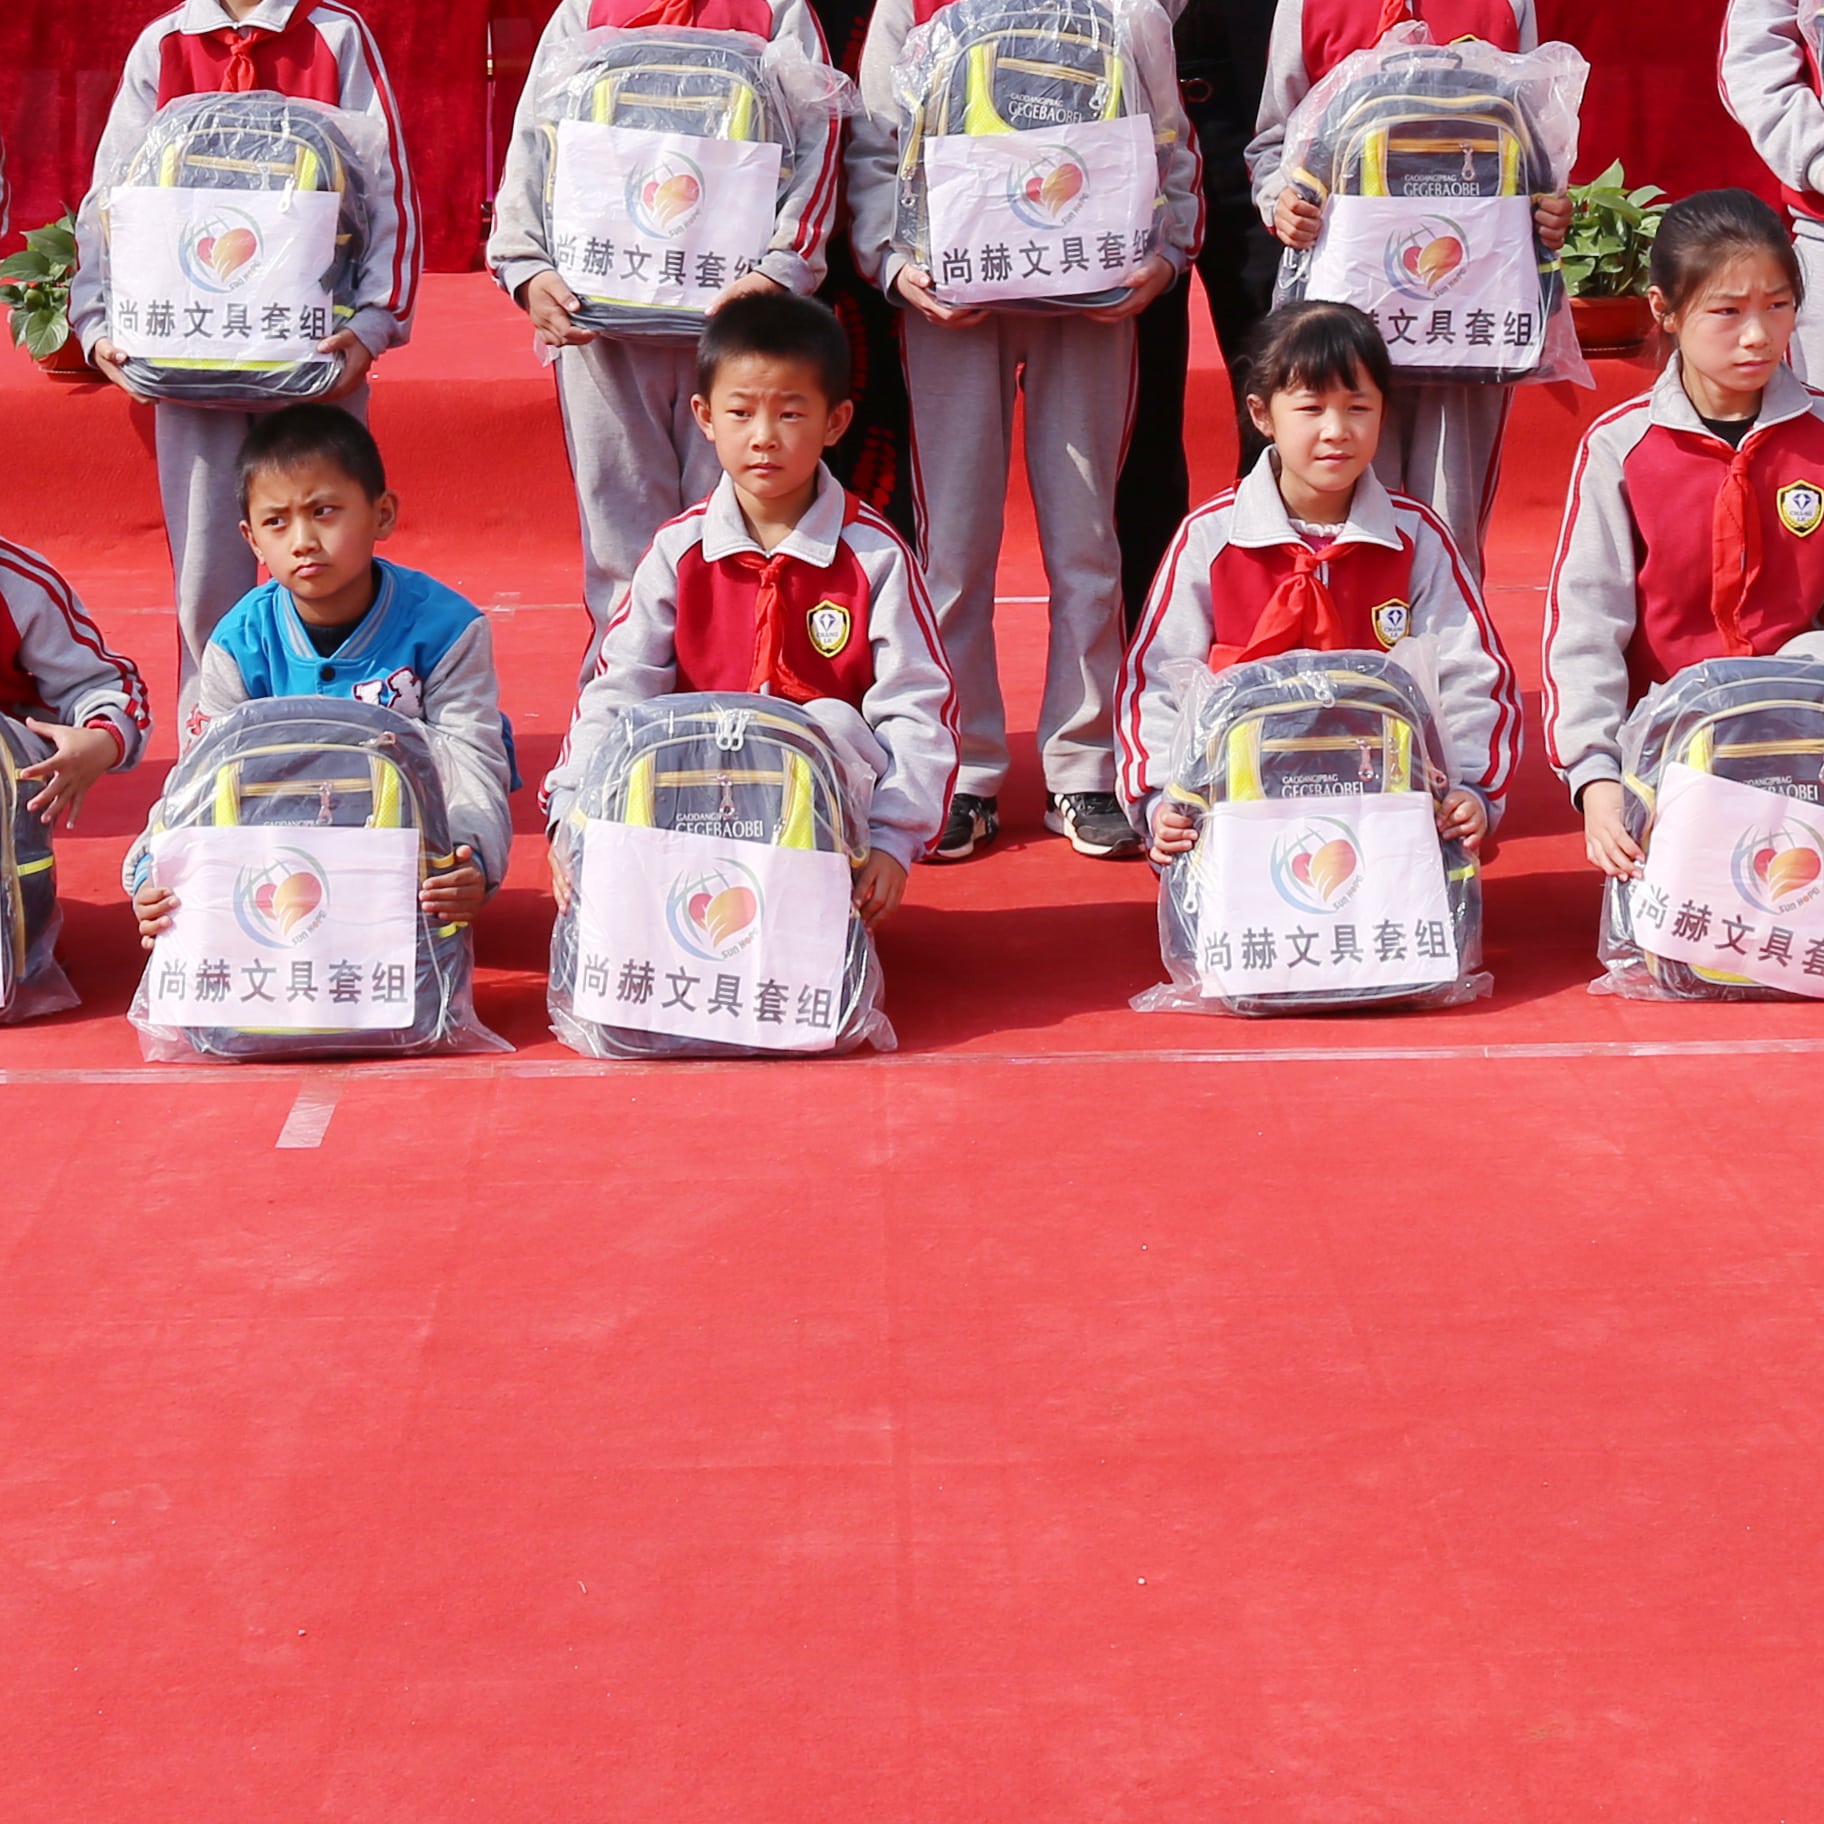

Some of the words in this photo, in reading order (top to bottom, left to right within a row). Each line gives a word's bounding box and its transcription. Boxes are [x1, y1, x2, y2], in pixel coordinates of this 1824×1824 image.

[118, 298, 326, 341] 尚赫文具套组
[1204, 918, 1451, 973] 尚赫文具套组
[158, 957, 409, 1004] 尚赫文具套组
[581, 953, 833, 1029] 尚赫文具套组
